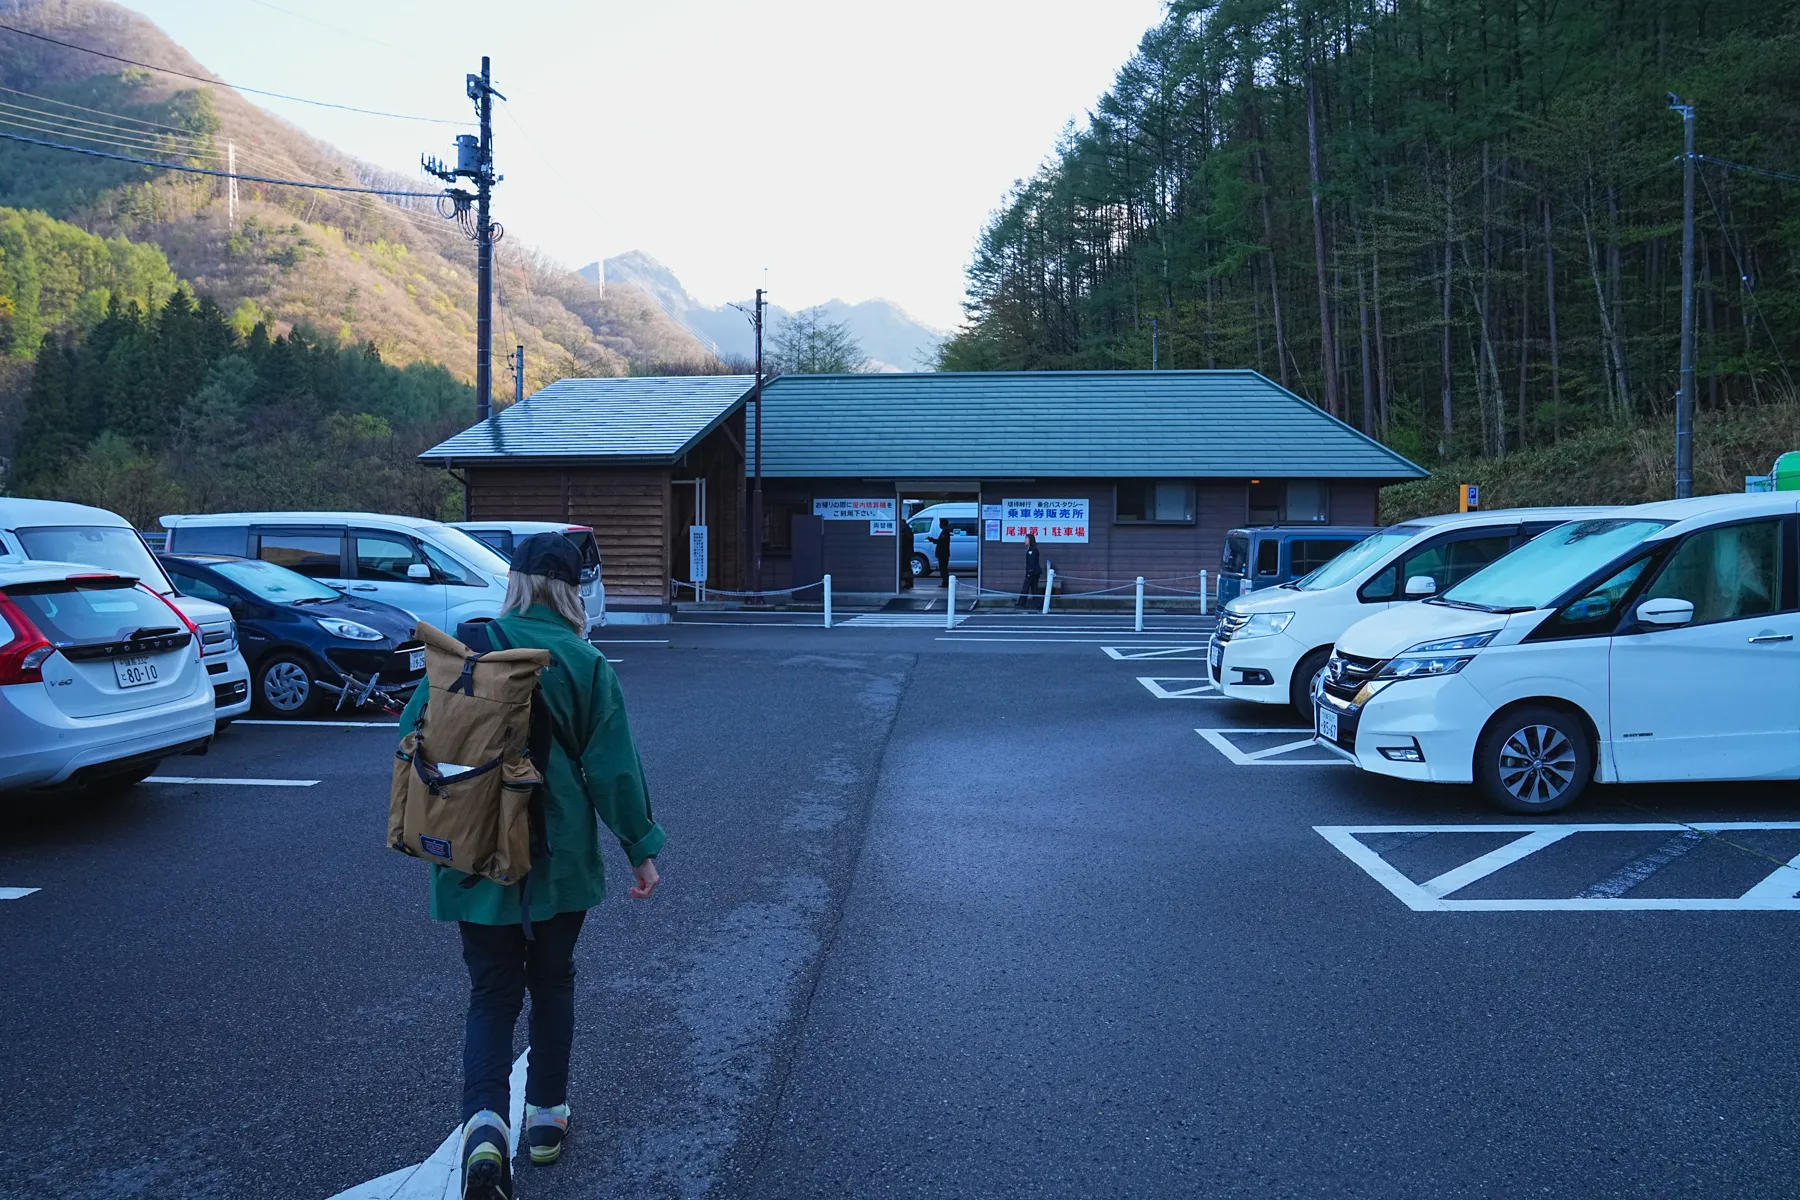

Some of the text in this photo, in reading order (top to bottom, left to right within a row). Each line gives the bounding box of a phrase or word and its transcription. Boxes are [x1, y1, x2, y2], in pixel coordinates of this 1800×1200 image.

[1470, 488, 1476, 498] P
[1007, 508, 1084, 519] 乗車券販売所
[105, 639, 173, 653] VOLVO
[50, 678, 73, 687] V60
